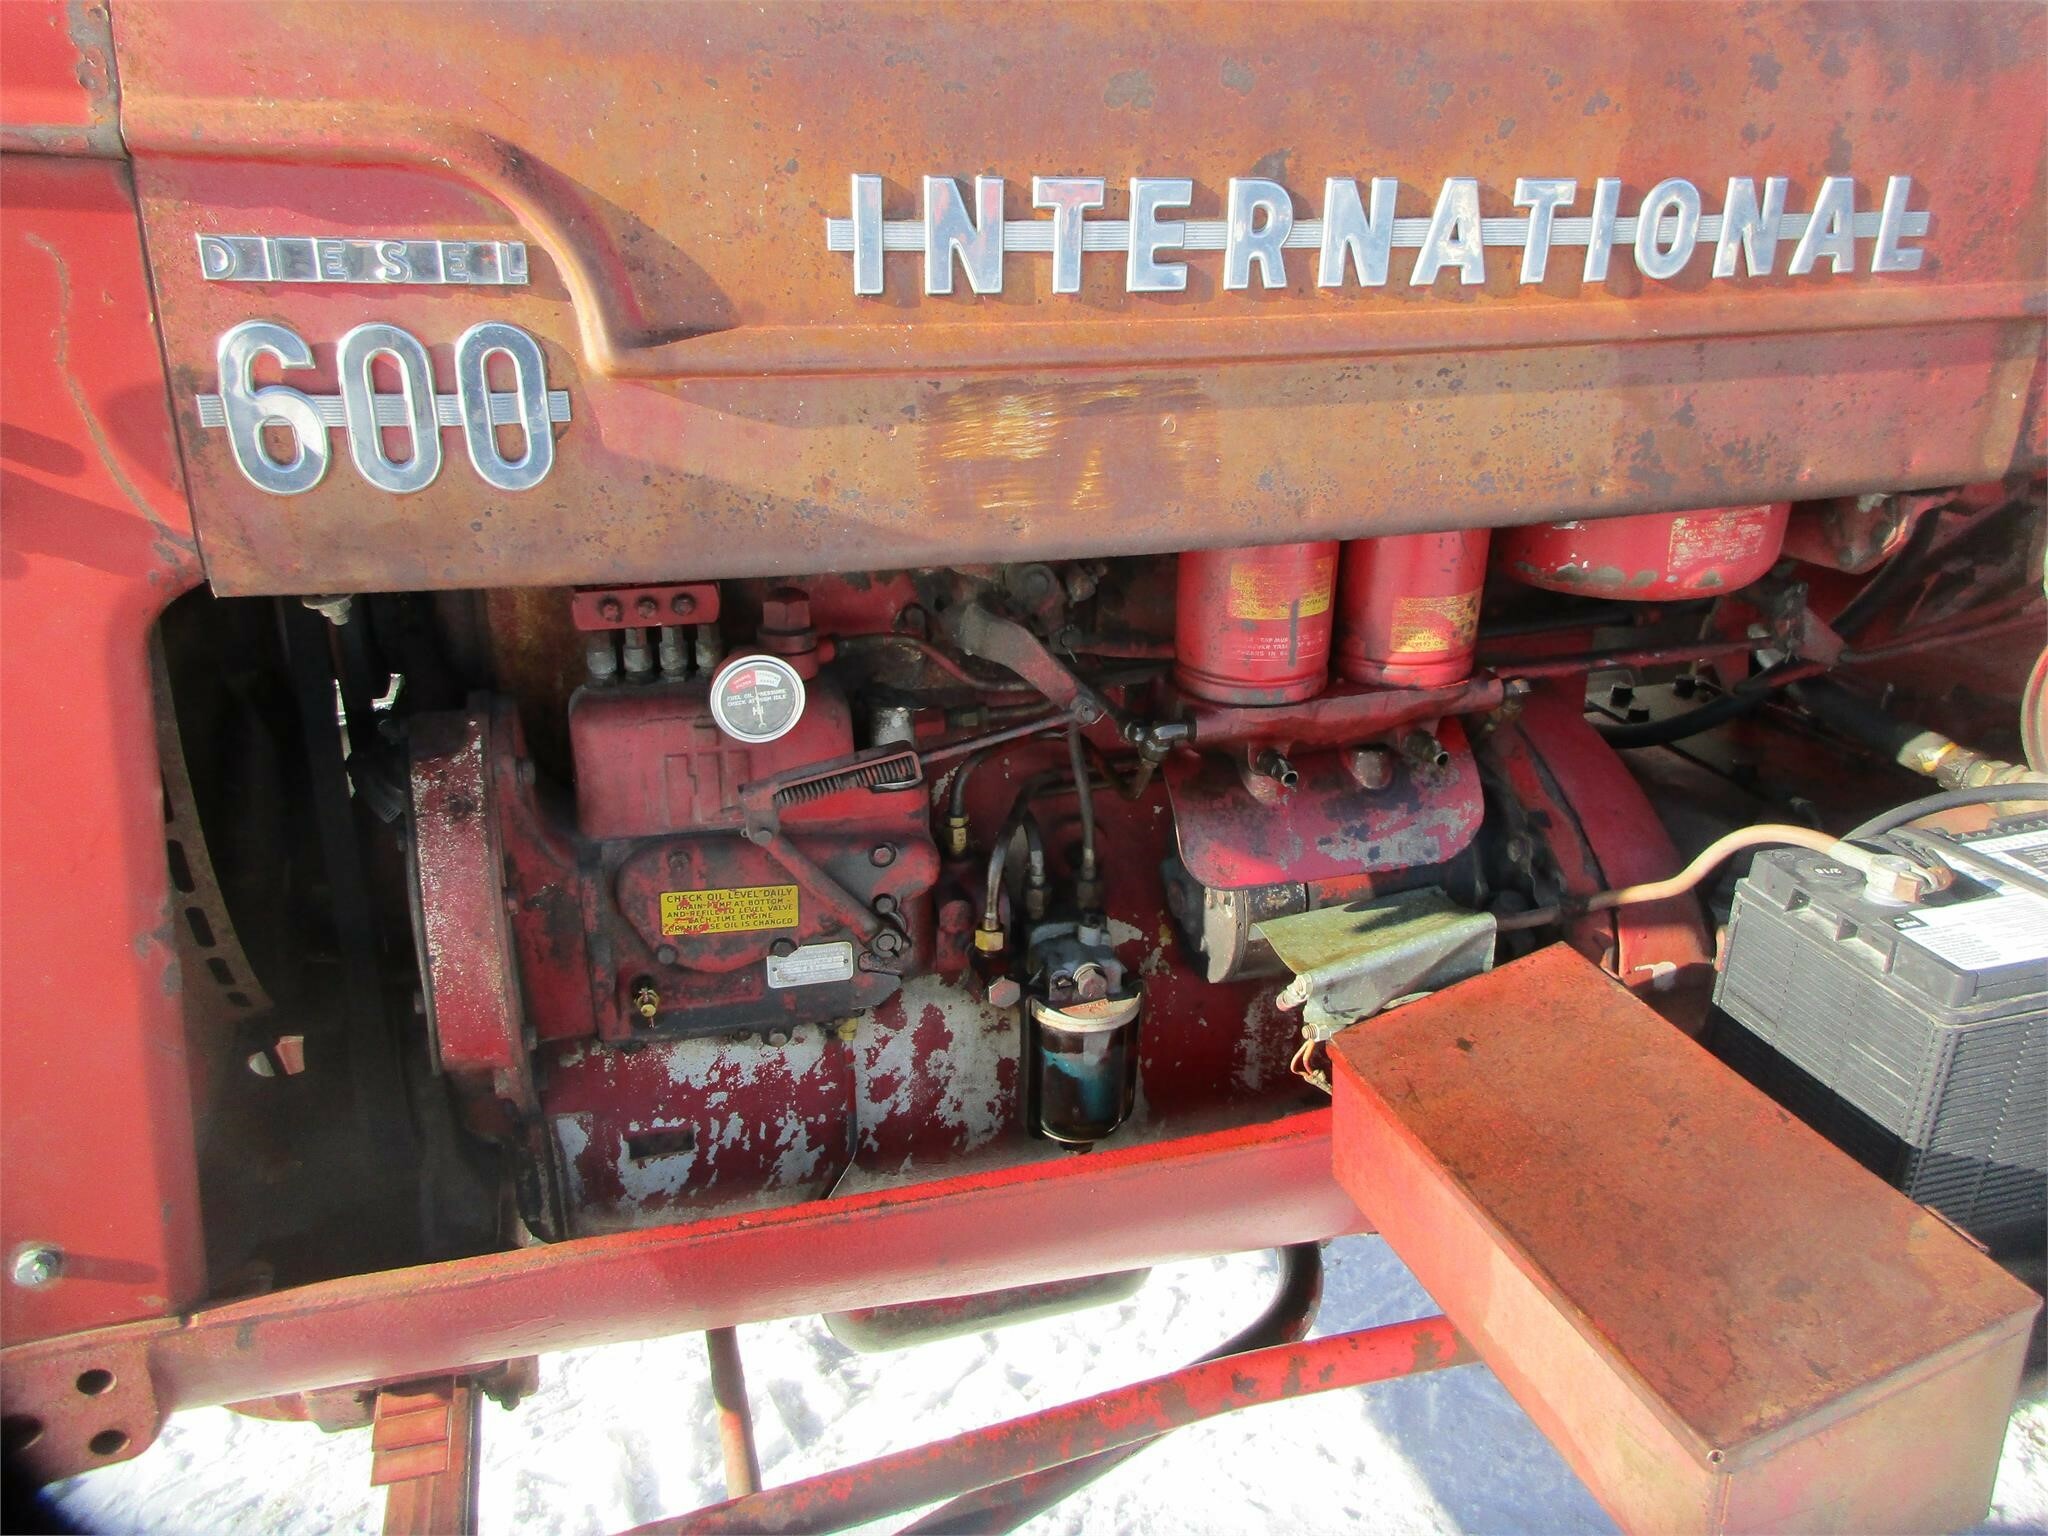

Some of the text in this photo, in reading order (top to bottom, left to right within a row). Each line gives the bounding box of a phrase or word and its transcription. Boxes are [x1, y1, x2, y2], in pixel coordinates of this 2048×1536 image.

[850, 174, 1924, 297] INTERNATIONAL
[200, 236, 528, 284] DIESEL
[217, 318, 556, 495] 600
[666, 888, 793, 903] CHECK OIL LEVEL DAILY
[748, 898, 784, 906] BOTTOM
[739, 906, 764, 914] LEVEL
[724, 921, 738, 929] OIL
[753, 918, 793, 926] CHANGED
